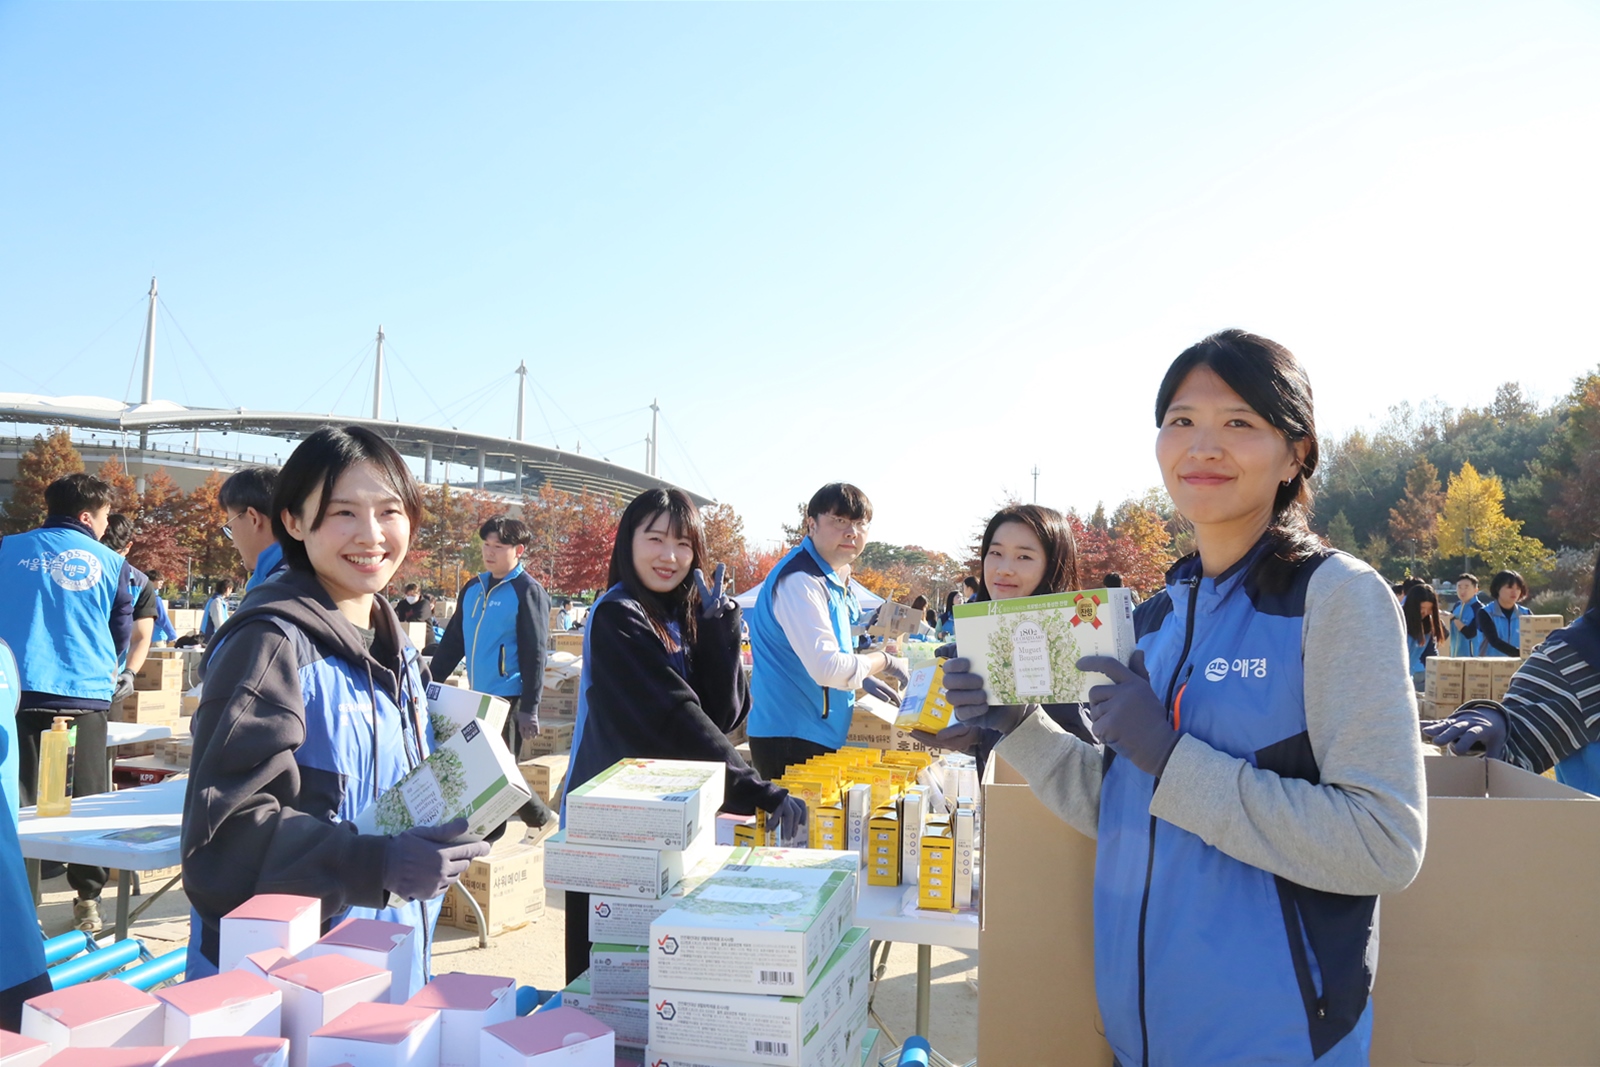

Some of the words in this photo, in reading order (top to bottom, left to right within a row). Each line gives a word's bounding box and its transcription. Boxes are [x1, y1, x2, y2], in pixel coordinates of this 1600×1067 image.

[1231, 658, 1267, 678] 애경
[140, 773, 154, 782] KPP
[493, 869, 528, 889] 샤워메이트
